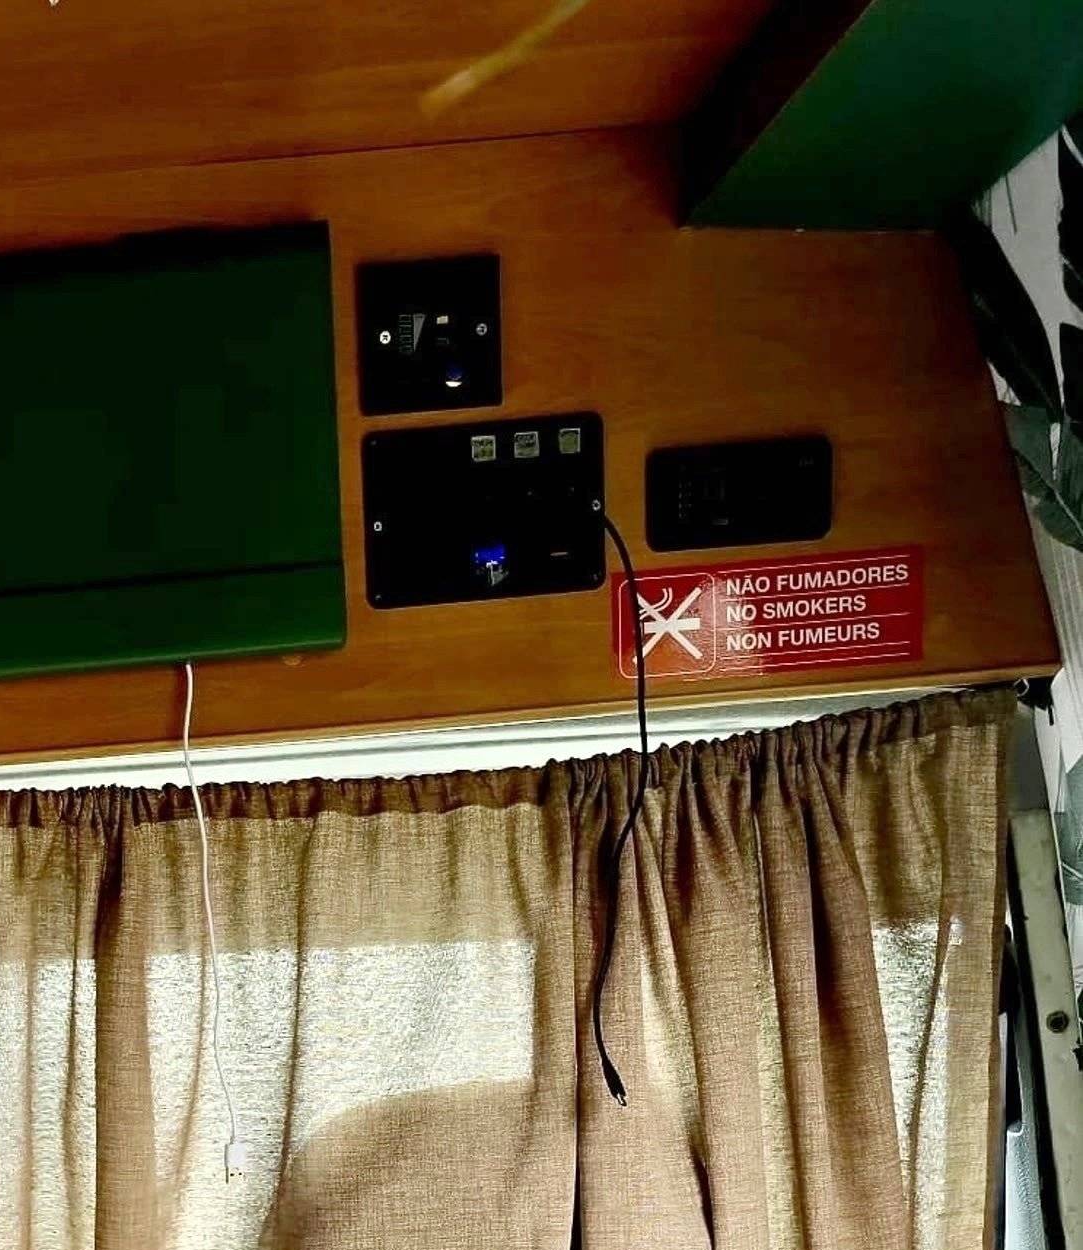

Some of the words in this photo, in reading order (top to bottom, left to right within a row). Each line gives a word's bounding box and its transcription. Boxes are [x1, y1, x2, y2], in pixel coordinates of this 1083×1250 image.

[725, 574, 771, 596] NÃO
[776, 563, 909, 591] FUMADORES
[725, 603, 758, 622] NO
[762, 595, 867, 620] SMOKERS
[725, 631, 774, 652] NON
[778, 622, 880, 647] FUMEURS
